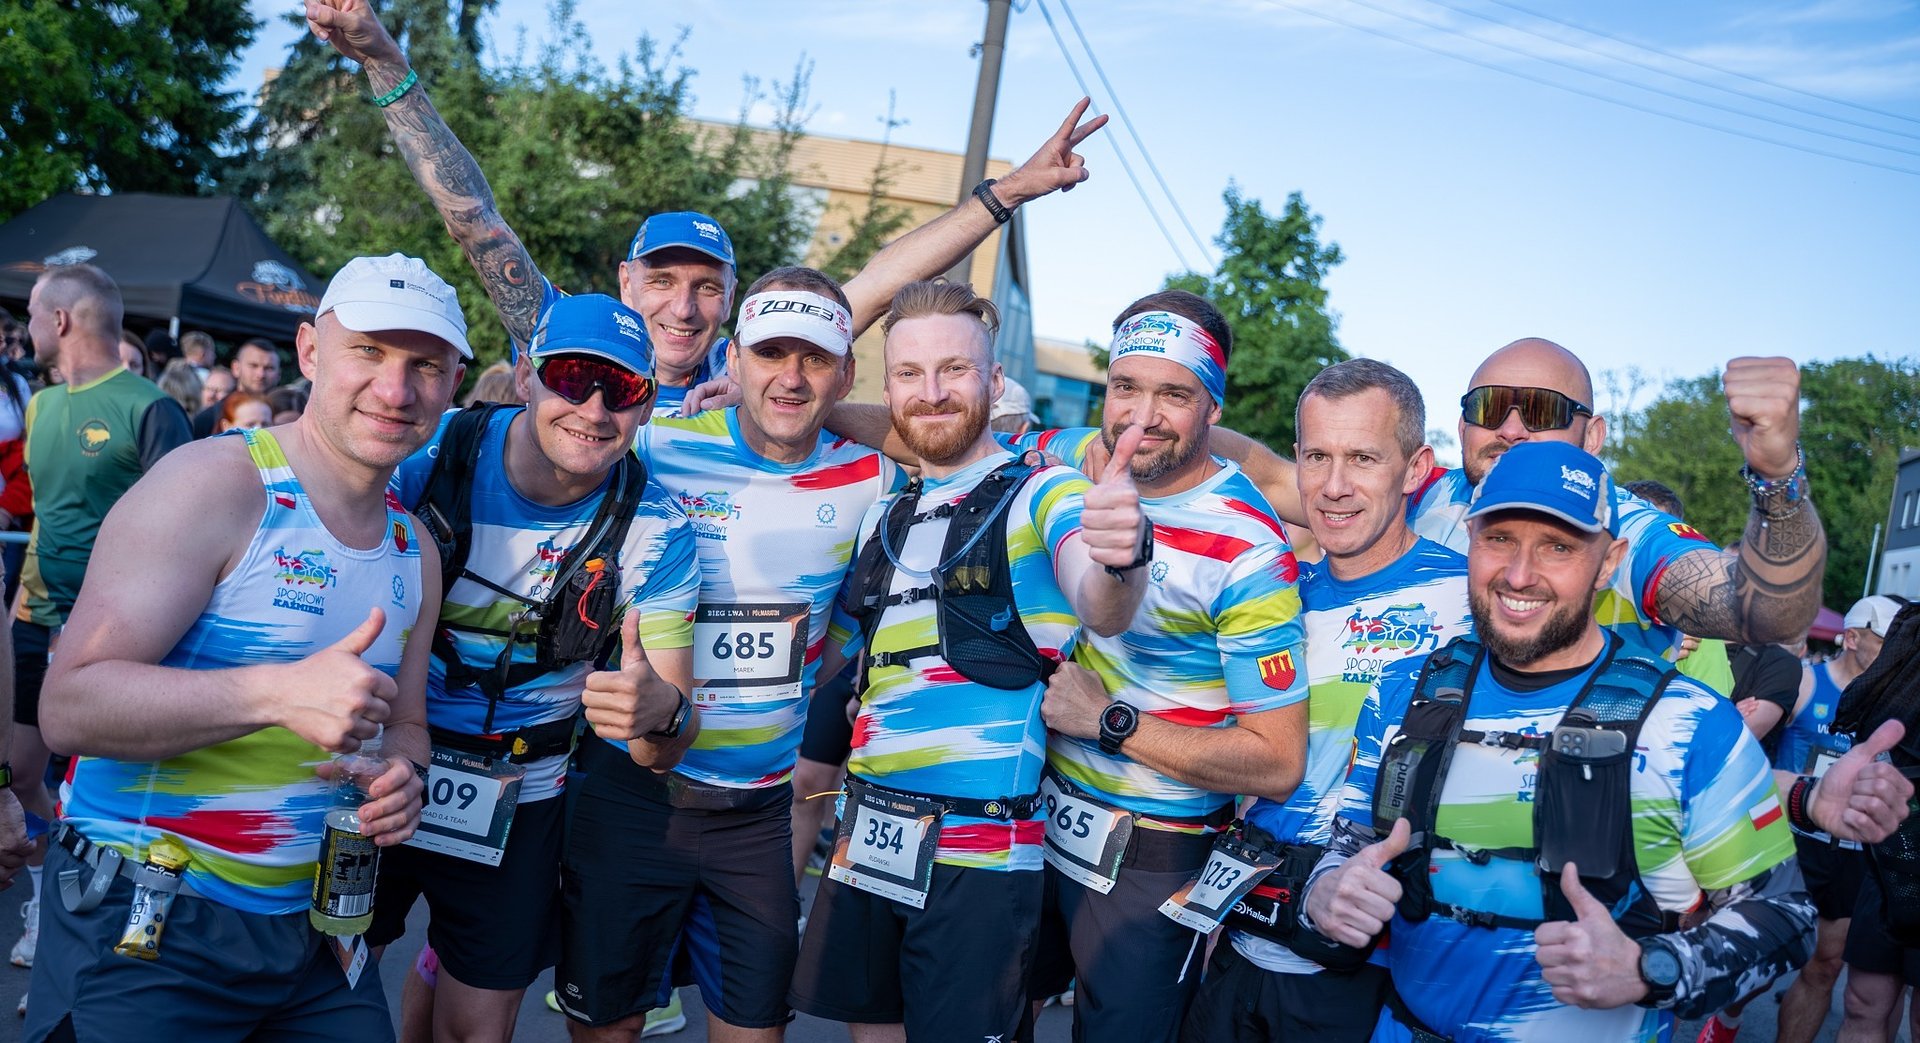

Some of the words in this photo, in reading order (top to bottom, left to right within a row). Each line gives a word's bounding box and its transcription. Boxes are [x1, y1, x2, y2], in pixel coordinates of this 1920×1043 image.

[758, 300, 834, 322] ZONE3
[690, 521, 727, 535] ORTOWY
[276, 587, 326, 606] SPORTOWY
[272, 598, 324, 616] KAŹMIERZ
[707, 609, 725, 617] BIEG
[712, 632, 774, 660] 685
[1344, 657, 1392, 672] SPORT
[436, 752, 453, 763] LWA
[432, 777, 478, 811] 09
[1391, 762, 1409, 808] purella
[438, 813, 448, 821] 0.4
[450, 815, 468, 826] TEAM
[1046, 794, 1095, 838] 965
[864, 817, 904, 855] 354
[1201, 860, 1241, 891] 1213
[1246, 906, 1272, 926] Kalen
